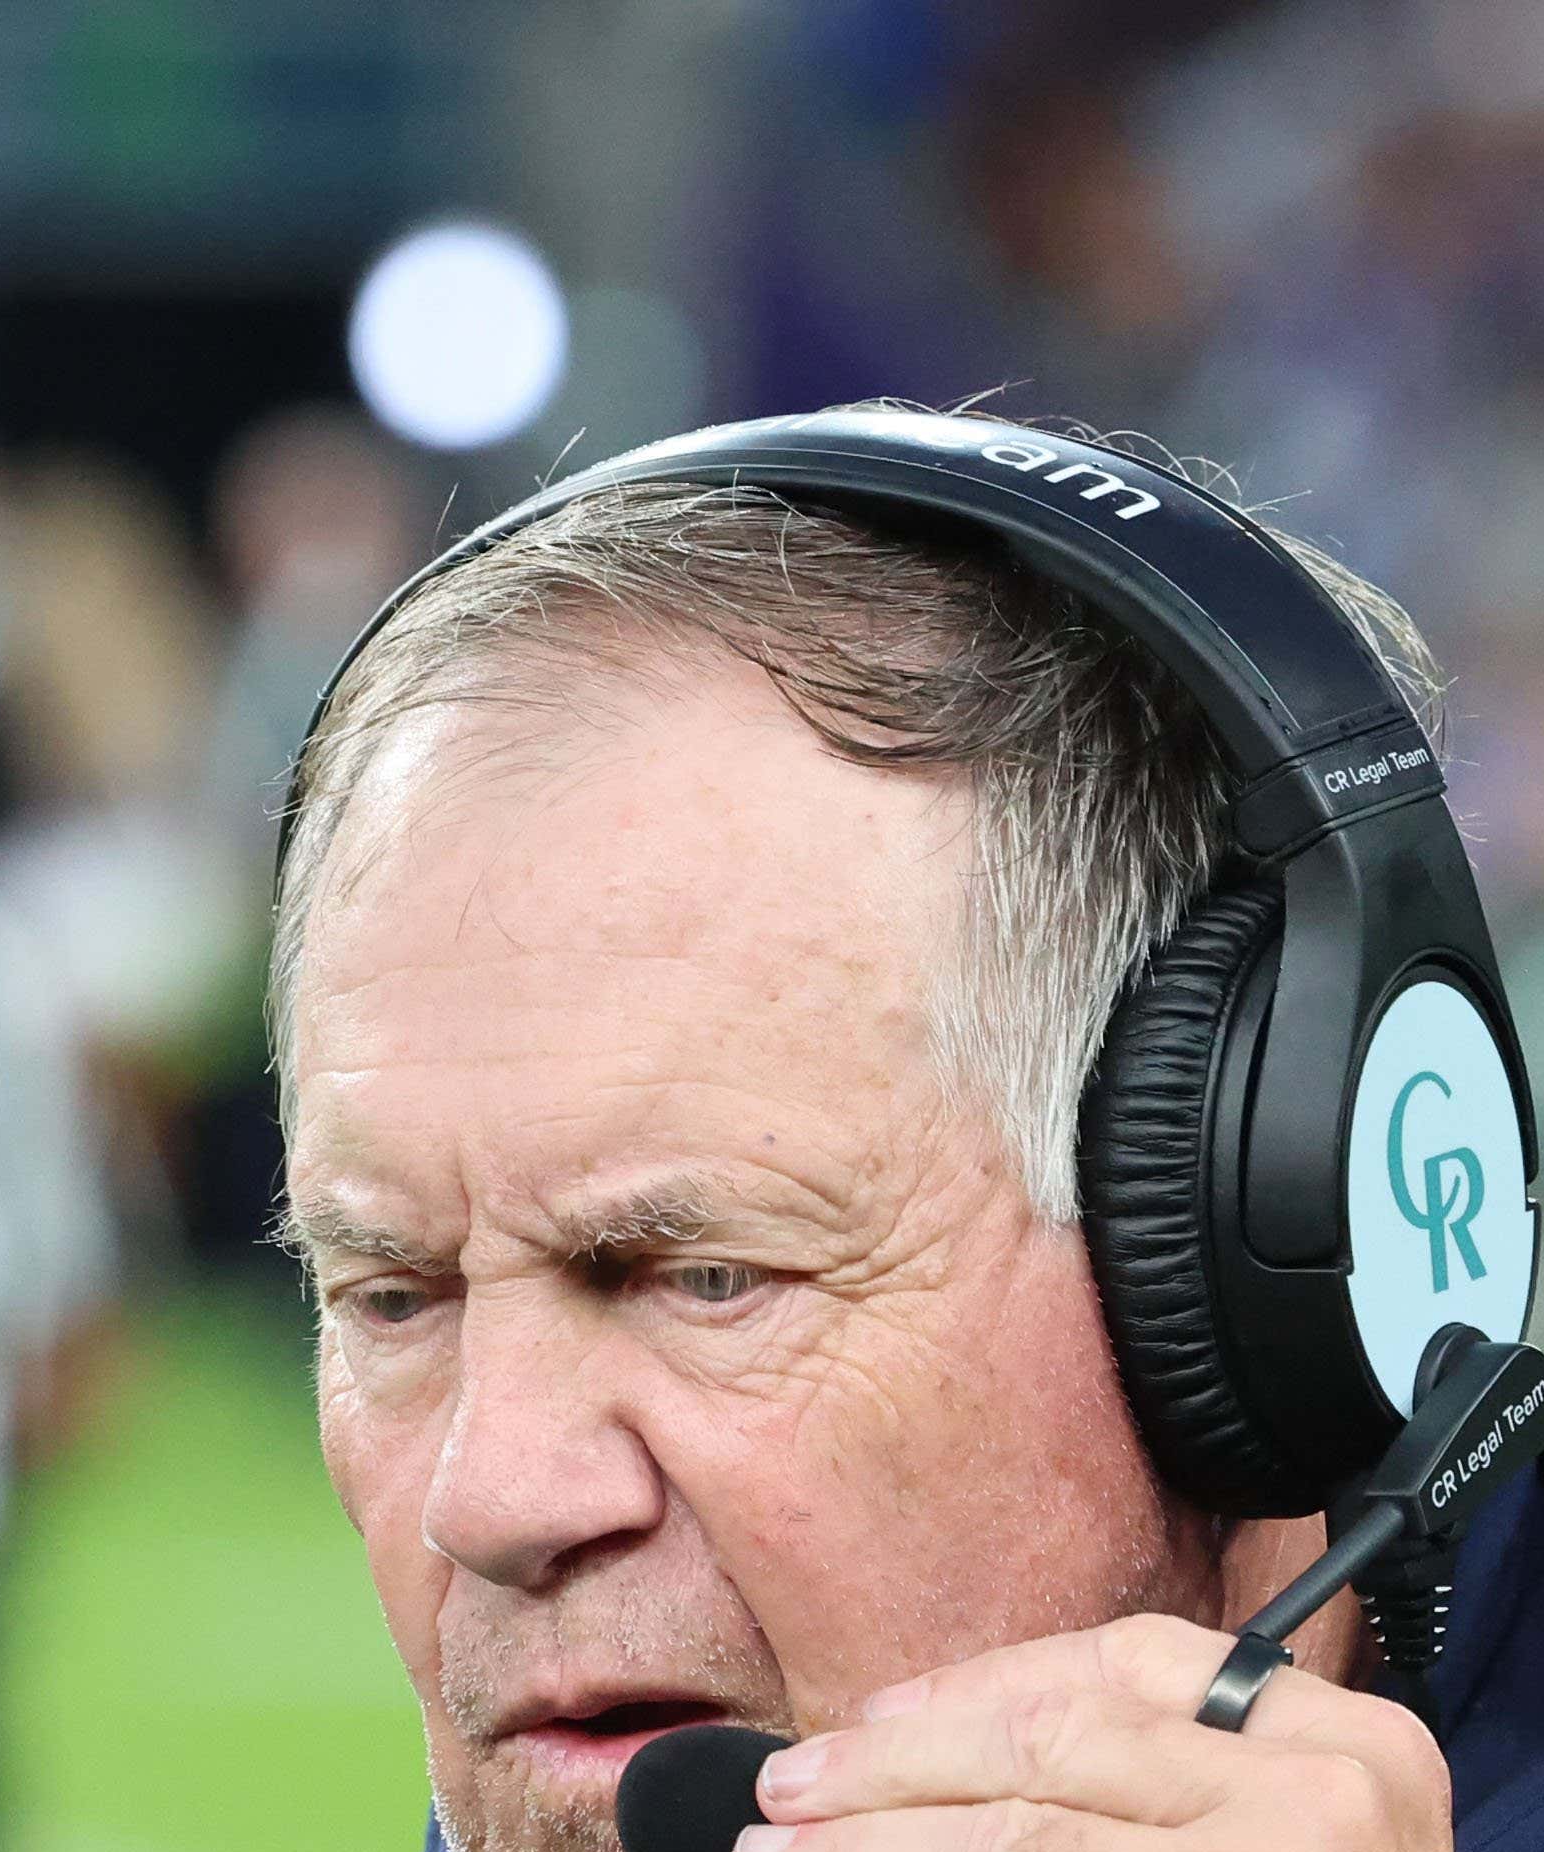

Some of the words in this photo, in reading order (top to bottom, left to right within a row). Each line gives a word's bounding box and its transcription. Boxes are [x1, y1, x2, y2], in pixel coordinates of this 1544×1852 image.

[1324, 770, 1351, 793] CR
[1348, 755, 1392, 785] Legal
[1388, 748, 1430, 771] Team
[1386, 1070, 1488, 1294] CR
[1431, 1469, 1458, 1508] CR
[1457, 1420, 1504, 1483] Legal
